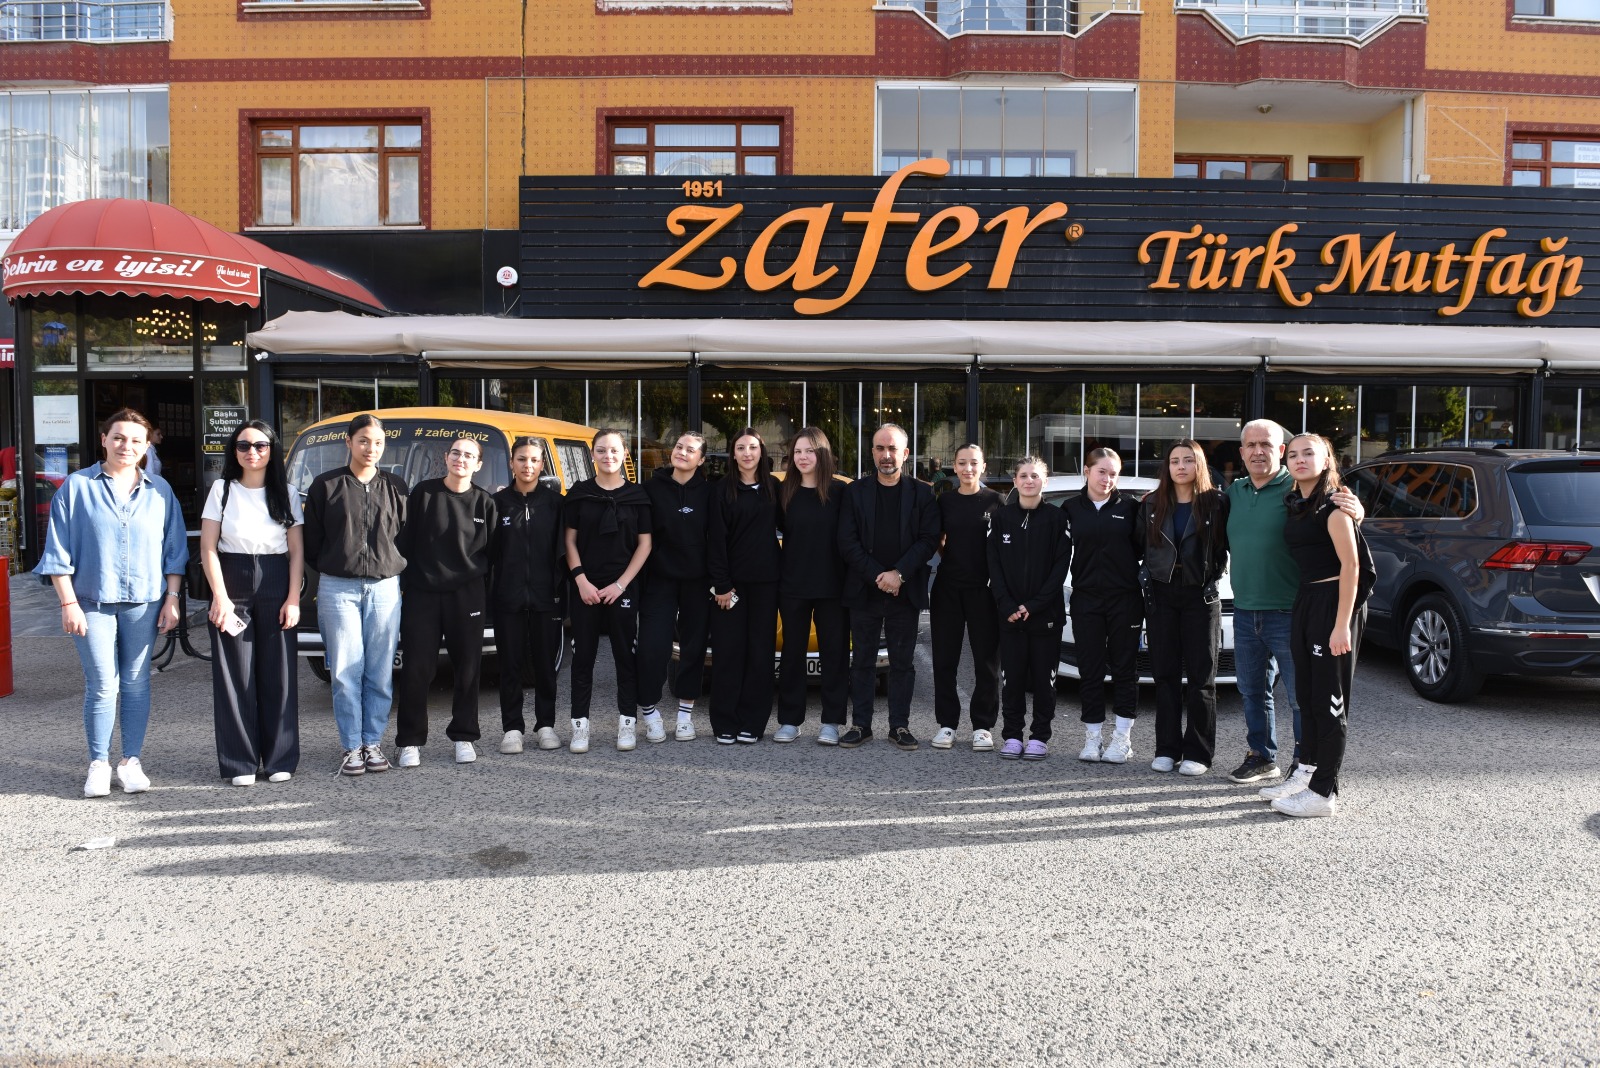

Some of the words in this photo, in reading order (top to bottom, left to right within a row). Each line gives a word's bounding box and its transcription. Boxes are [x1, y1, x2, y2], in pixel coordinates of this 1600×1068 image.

[682, 180, 723, 198] 1951
[638, 158, 1069, 315] zafer
[66, 259, 104, 272] en
[114, 255, 205, 278] iyisi!
[1138, 222, 1313, 307] Türk
[1315, 227, 1584, 317] Mutfağı
[0, 348, 15, 362] in
[209, 418, 243, 426] Şubemiz
[213, 410, 238, 418] Başka
[425, 428, 489, 442] zafer'deyiz
